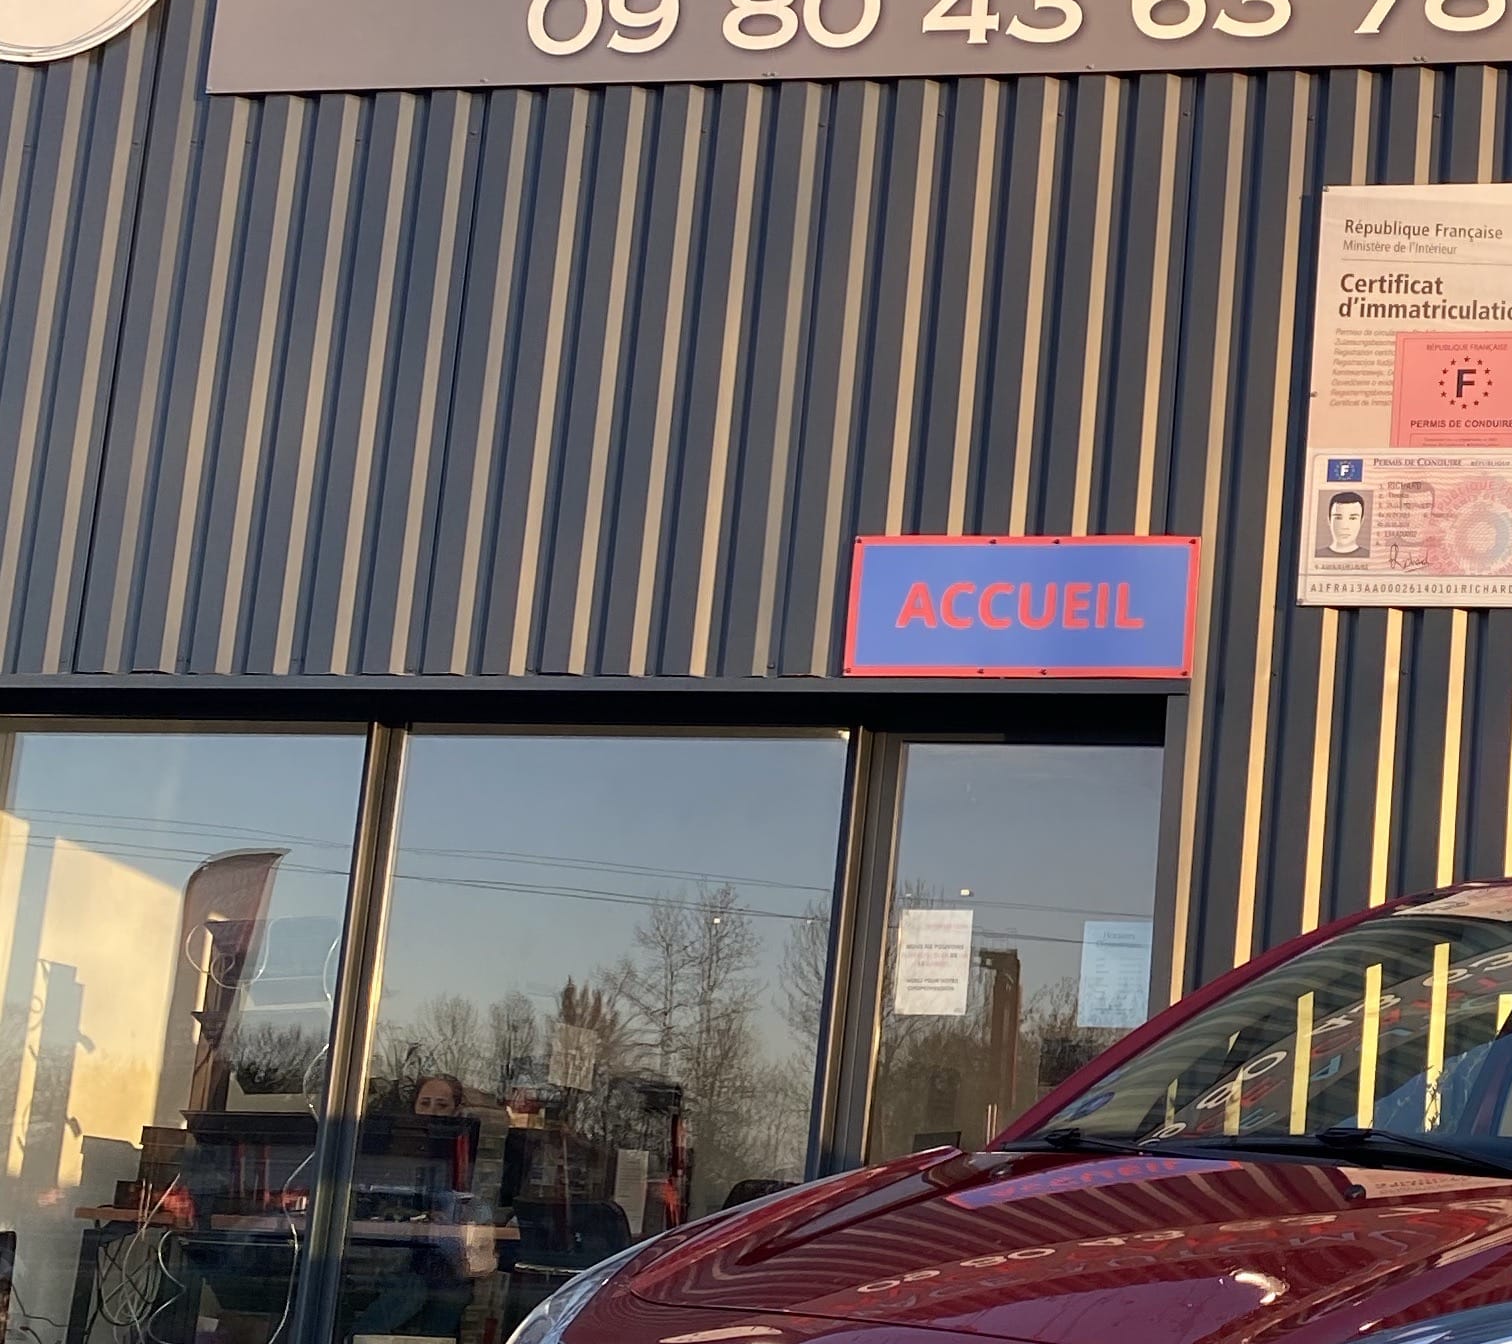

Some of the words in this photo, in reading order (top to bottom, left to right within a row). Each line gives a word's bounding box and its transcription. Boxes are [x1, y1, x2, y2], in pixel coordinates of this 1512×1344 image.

[1344, 218, 1430, 240] République
[1434, 222, 1503, 242] Française
[1342, 239, 1391, 253] Ministère
[1393, 241, 1406, 253] de
[1340, 273, 1444, 295] Certificat
[1456, 368, 1476, 398] F
[1410, 419, 1446, 428] PERMIS
[1448, 419, 1461, 428] DE
[895, 581, 1145, 629] ACCUEIL
